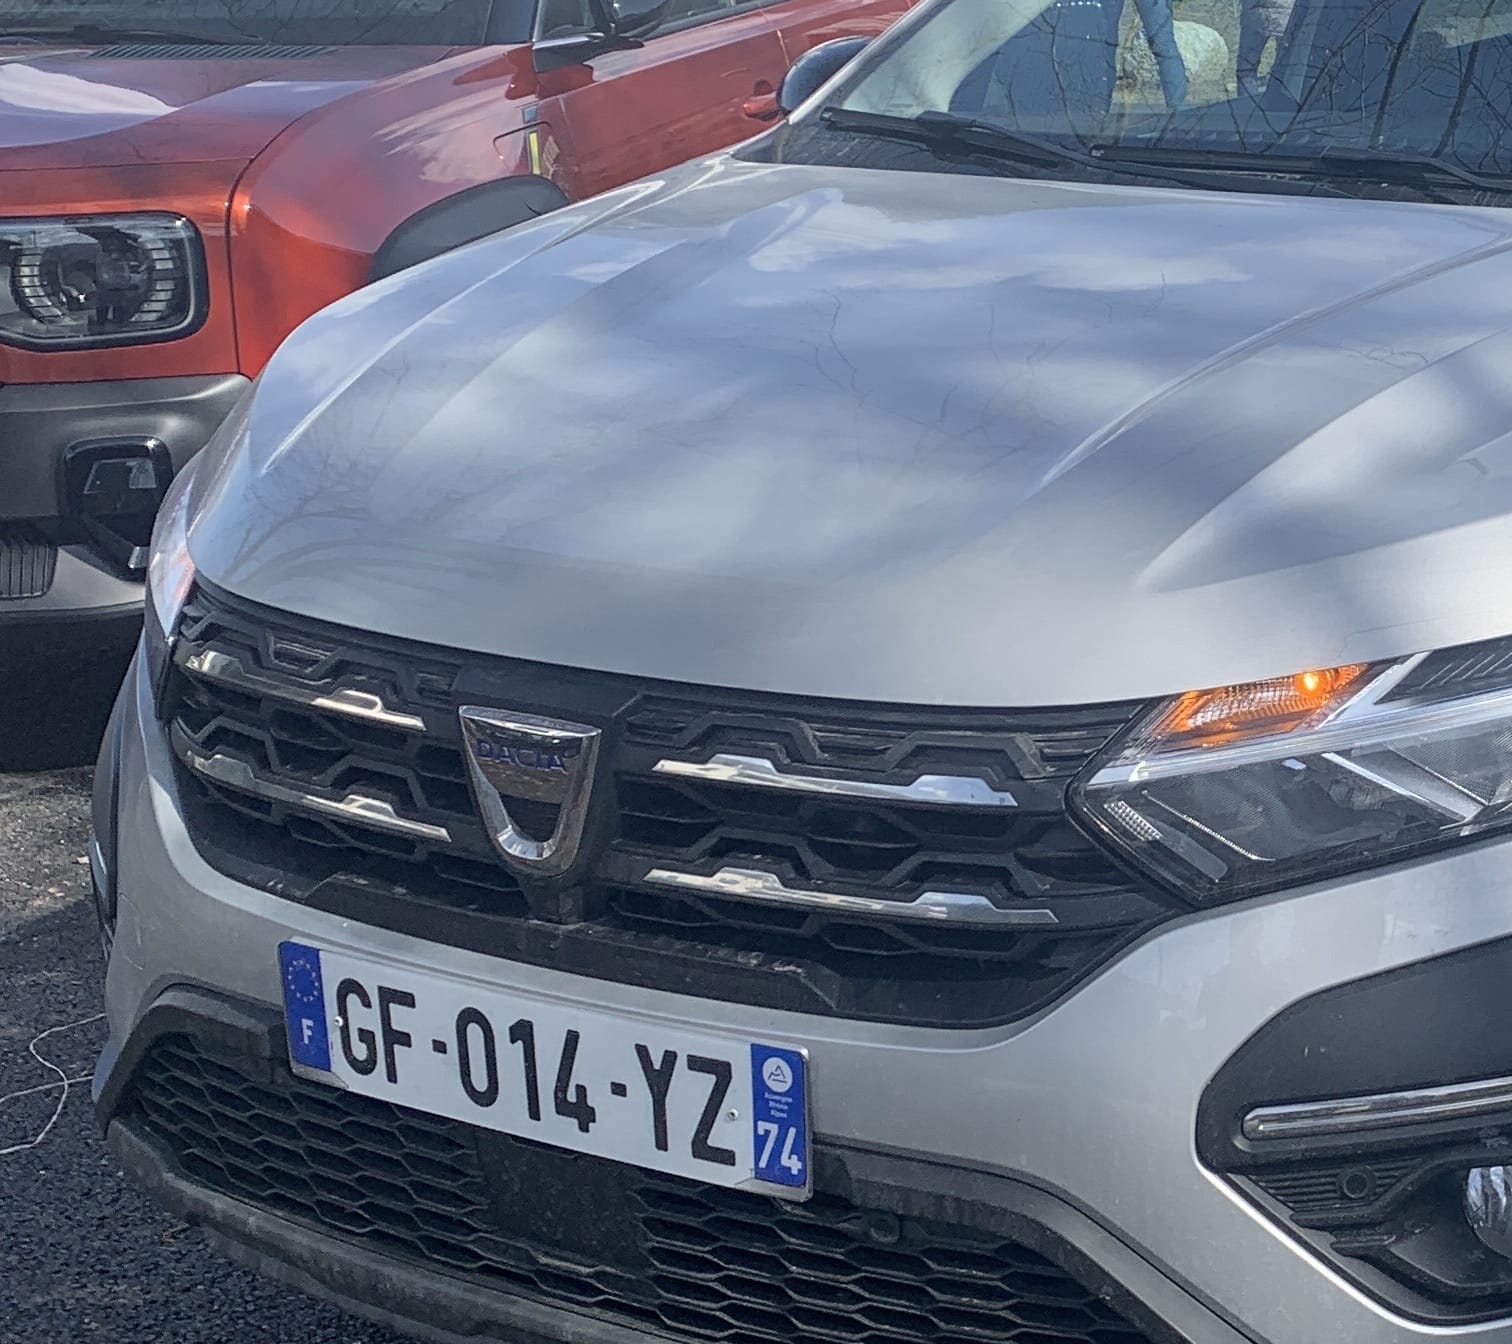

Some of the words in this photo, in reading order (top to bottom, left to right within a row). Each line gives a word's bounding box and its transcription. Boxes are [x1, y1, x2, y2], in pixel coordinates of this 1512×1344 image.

[476, 739, 569, 775] DACIA
[300, 1017, 314, 1045] F
[335, 977, 737, 1167] GF-014-YZ
[756, 1120, 803, 1176] 74
